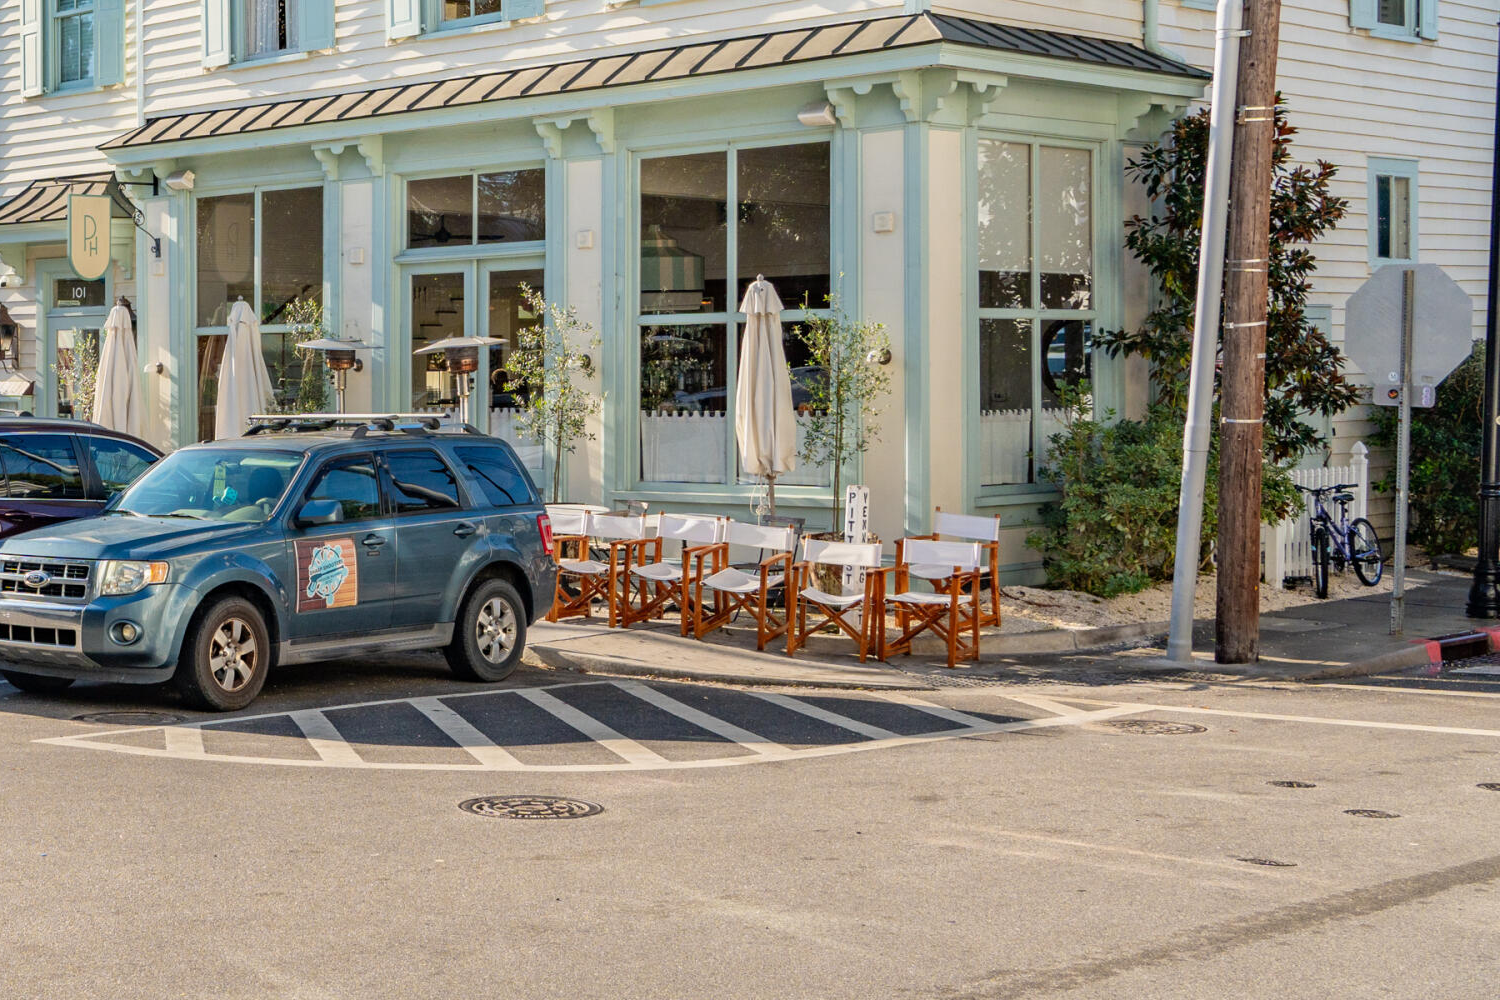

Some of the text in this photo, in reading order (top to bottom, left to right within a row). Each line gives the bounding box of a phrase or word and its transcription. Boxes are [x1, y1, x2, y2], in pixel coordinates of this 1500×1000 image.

[84, 215, 98, 256] PH
[72, 287, 86, 299] 101
[847, 492, 856, 543] PITT
